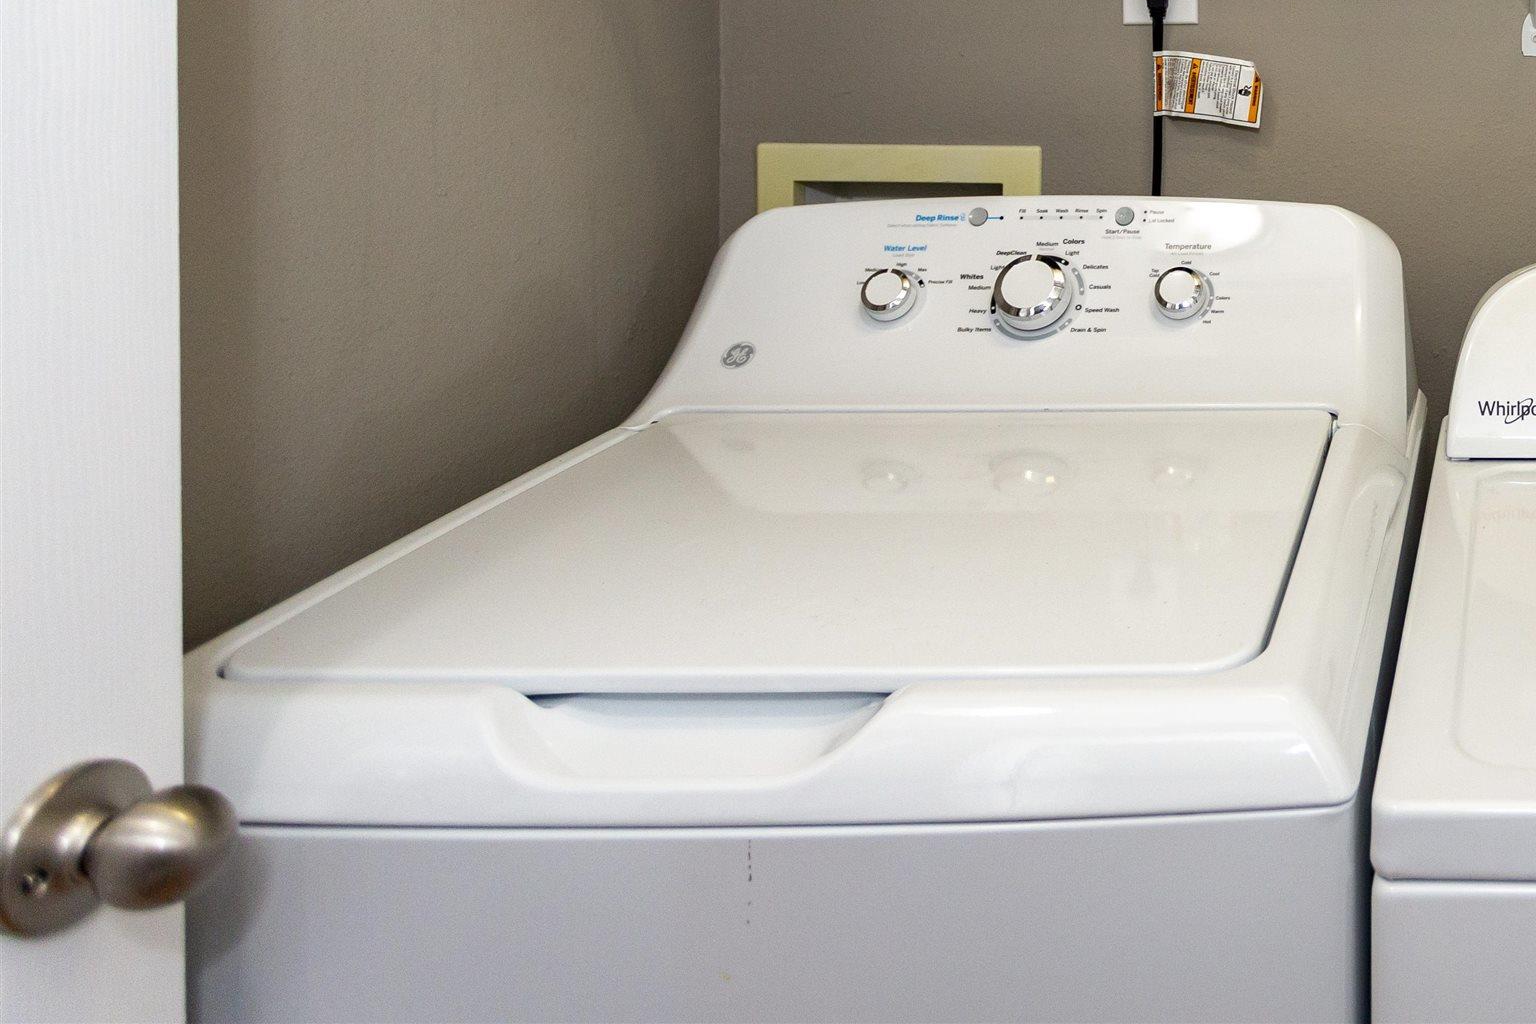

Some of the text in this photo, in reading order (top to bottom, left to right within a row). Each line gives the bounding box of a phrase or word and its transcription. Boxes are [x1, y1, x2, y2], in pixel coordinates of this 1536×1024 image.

[915, 214, 936, 222] Deep
[883, 244, 928, 252] Water Level
[1165, 243, 1212, 251] Temperature
